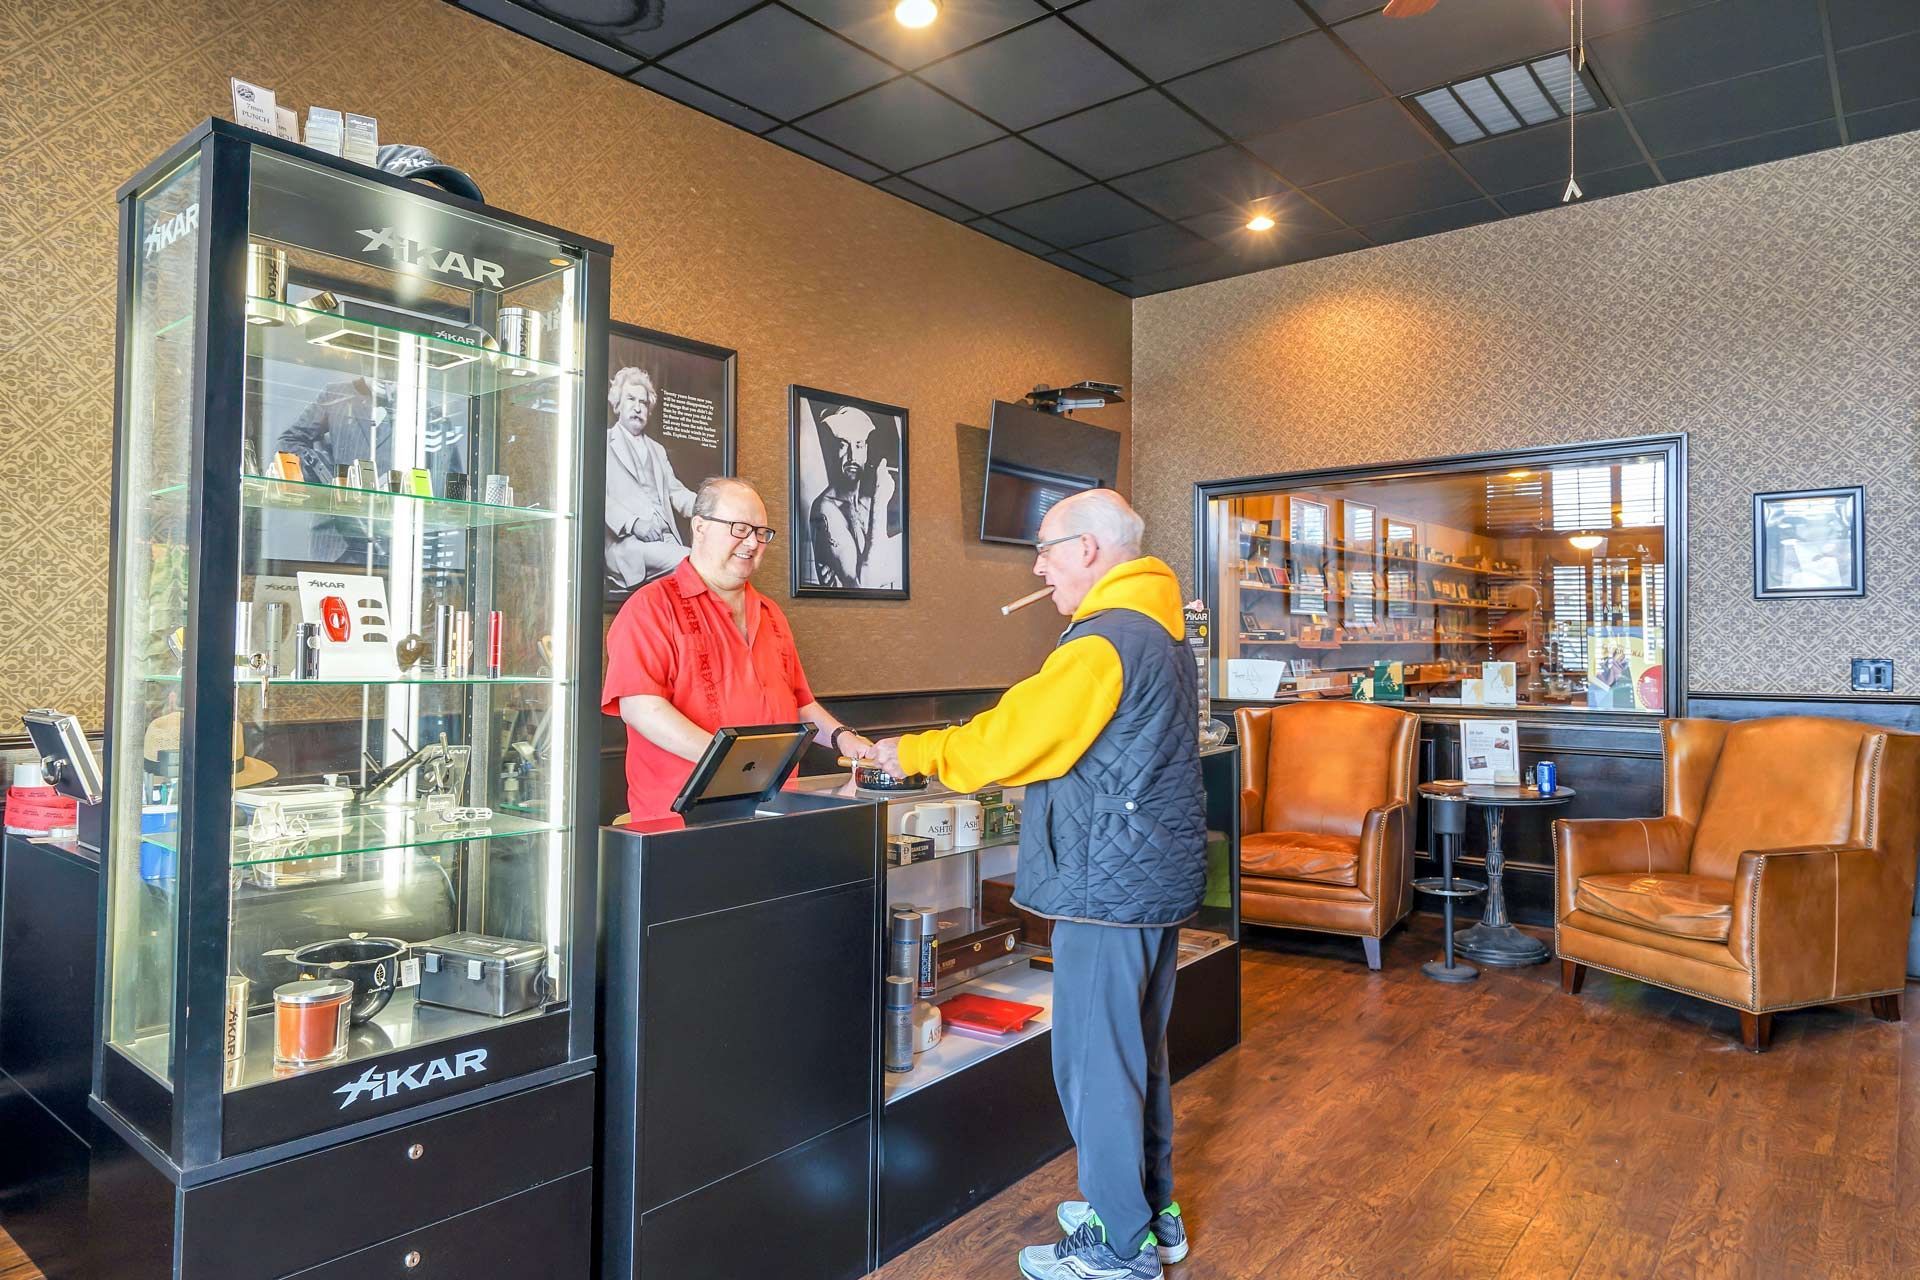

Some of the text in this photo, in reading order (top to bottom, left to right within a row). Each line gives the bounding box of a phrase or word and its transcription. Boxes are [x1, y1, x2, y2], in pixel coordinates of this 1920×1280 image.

[242, 110, 270, 124] PUNCH
[308, 578, 345, 589] XIKAR
[333, 1047, 488, 1110] XIKAR
